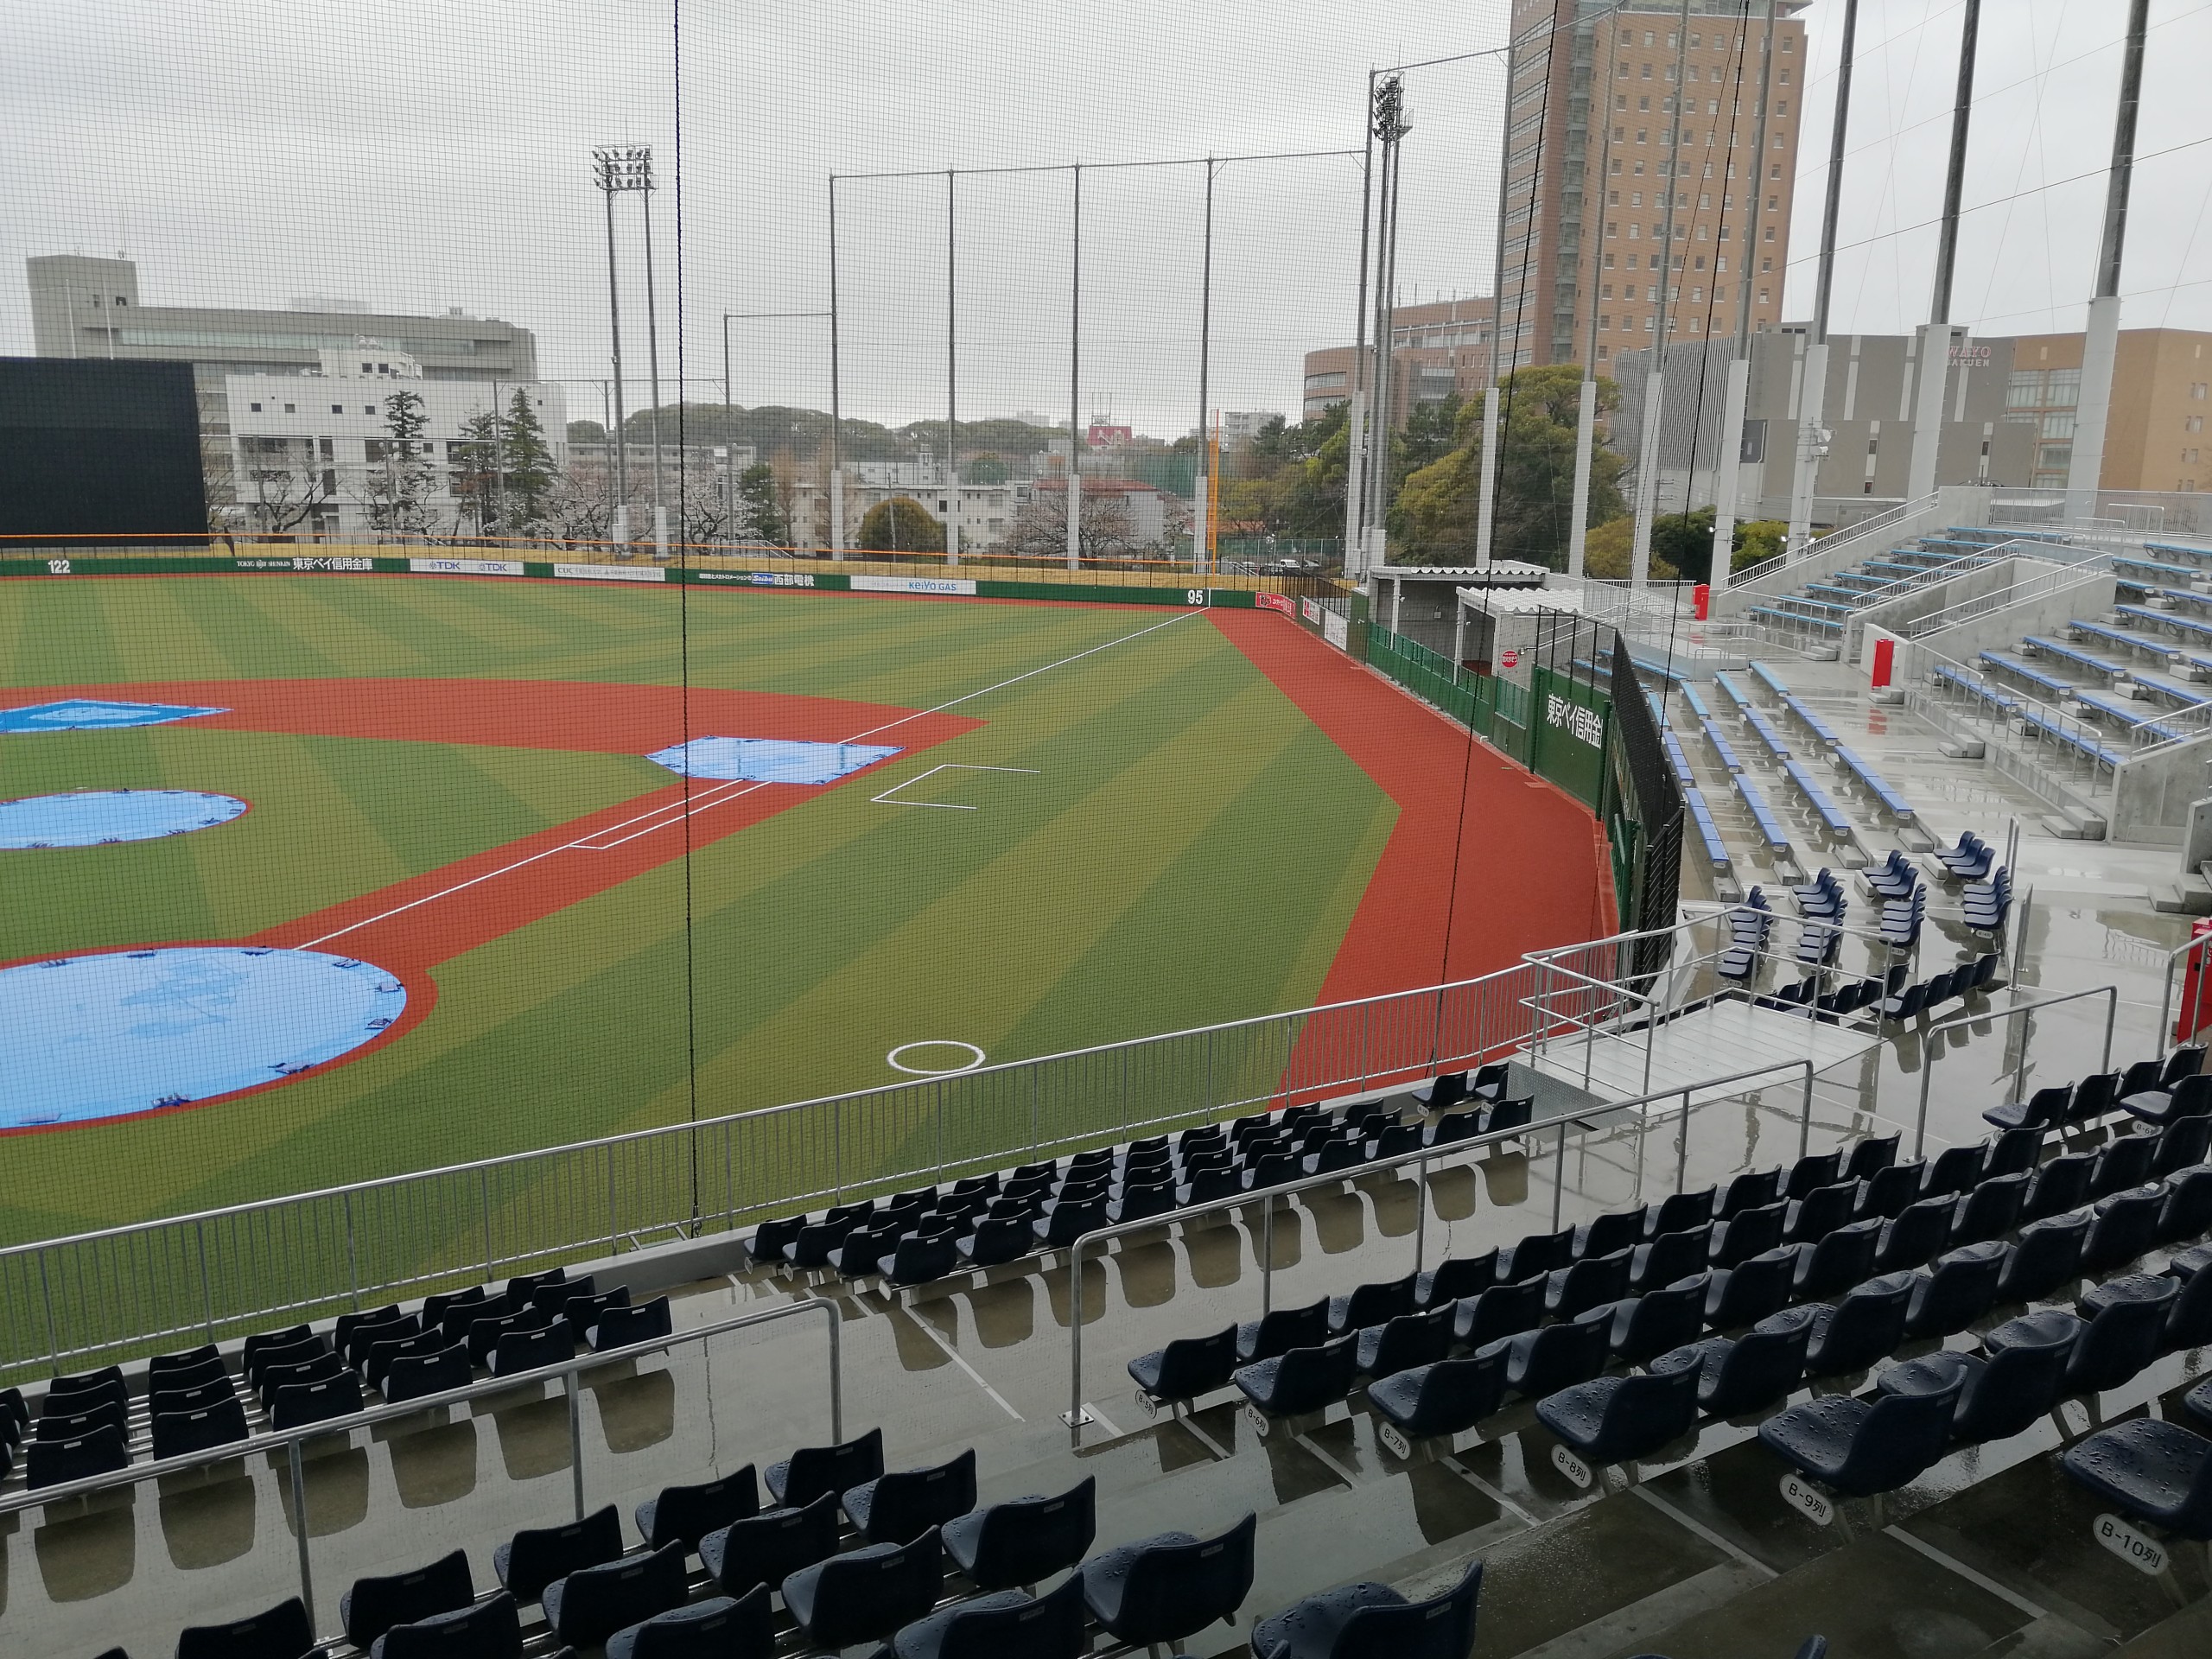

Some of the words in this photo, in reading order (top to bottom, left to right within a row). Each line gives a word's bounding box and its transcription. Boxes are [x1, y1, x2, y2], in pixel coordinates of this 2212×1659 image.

[48, 559, 71, 574] 122
[292, 557, 373, 570] 東京ベイ信用金庫
[774, 574, 815, 587] 西部電機
[938, 582, 957, 591] GAS
[1187, 589, 1204, 605] 95
[1547, 693, 1604, 750] 東京ベイ信用金
[1139, 1394, 1154, 1414] B-5列
[1248, 1408, 1266, 1432] B-6列
[1384, 1427, 1407, 1454] B-7列
[1558, 1452, 1586, 1482] B-8列
[1789, 1482, 1827, 1518] B-9列
[2101, 1521, 2162, 1568] B-10列
